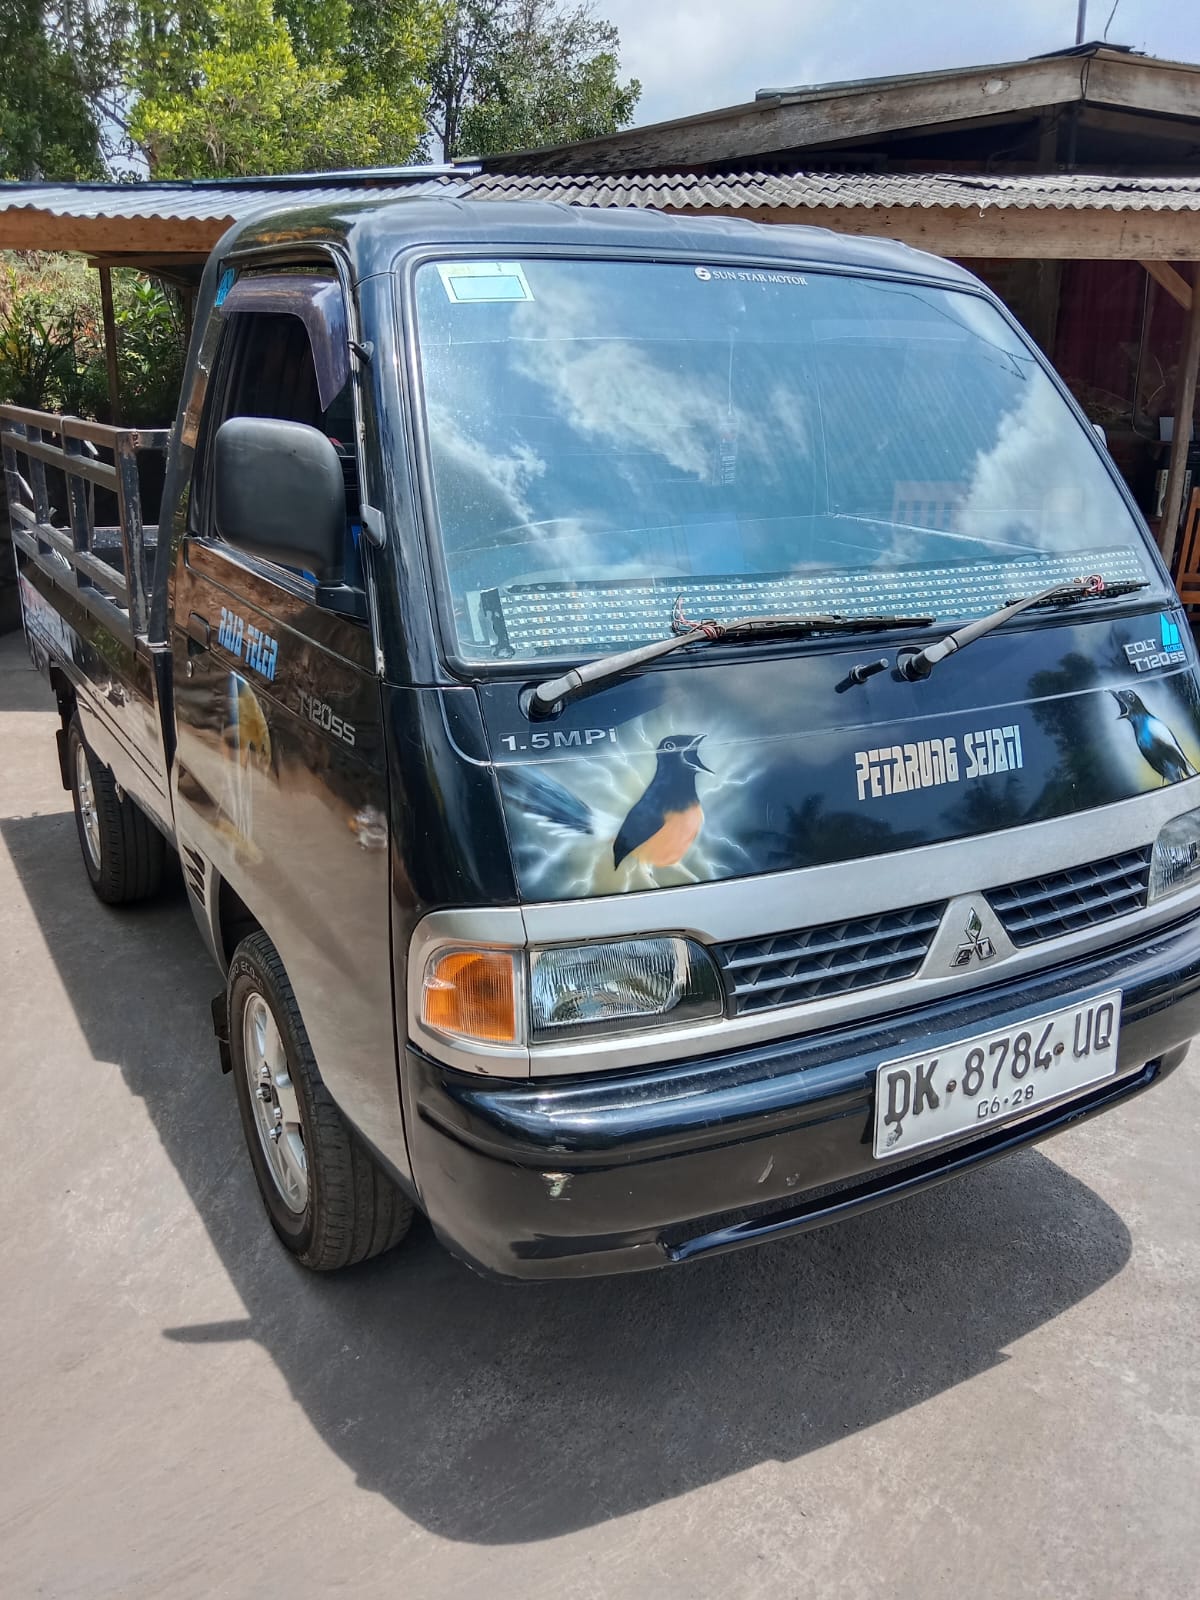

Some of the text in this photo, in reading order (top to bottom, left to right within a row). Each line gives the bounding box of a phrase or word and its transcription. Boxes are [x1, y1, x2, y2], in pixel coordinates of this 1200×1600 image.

[713, 271, 808, 286] SUN STAR MOTOR
[1123, 638, 1156, 655] COLT
[1129, 651, 1187, 672] T120SS
[855, 724, 1023, 801] PETARUNG SEJATI
[884, 1002, 1114, 1127] DK 8784 UQ
